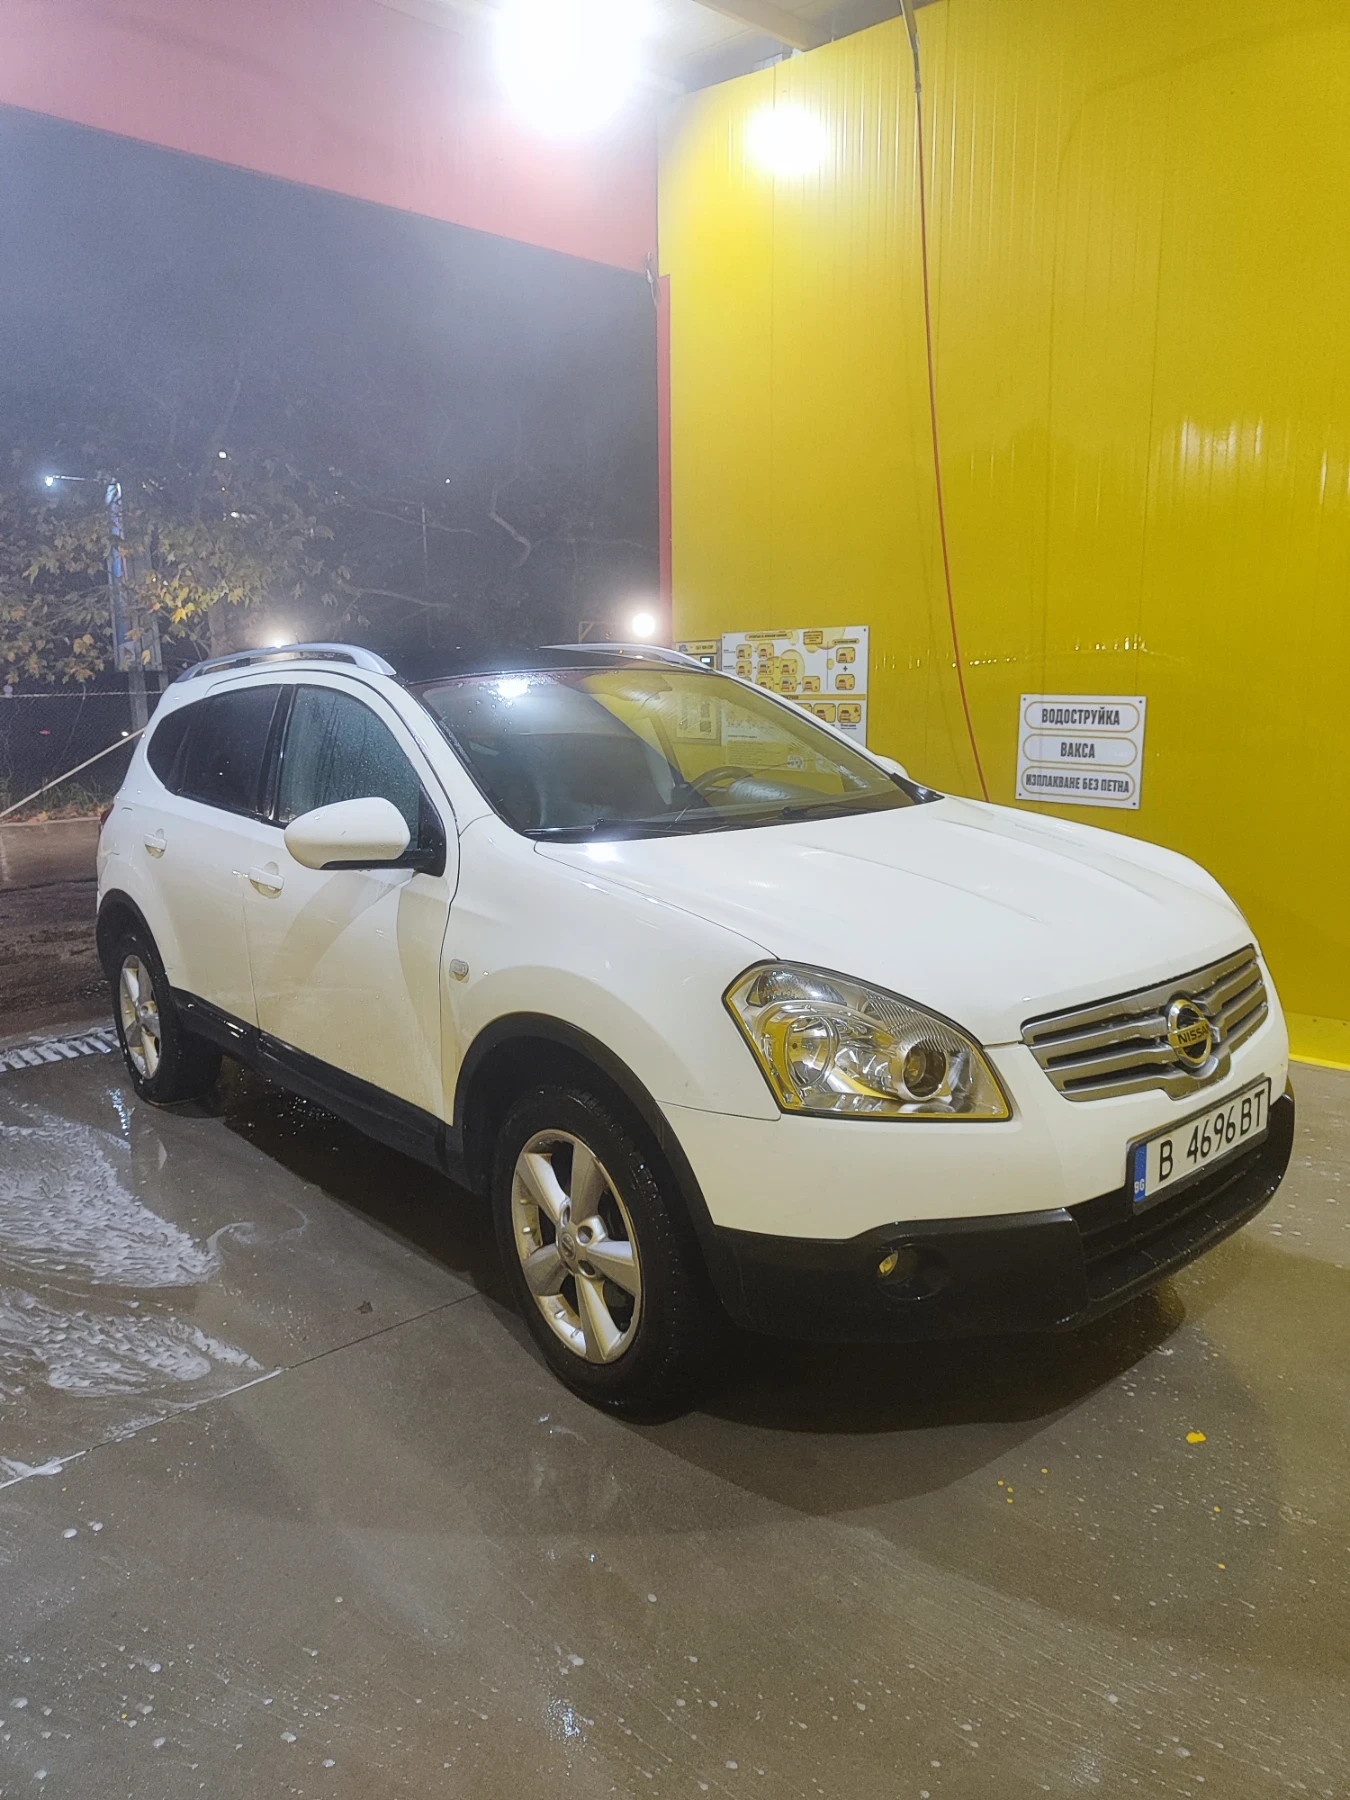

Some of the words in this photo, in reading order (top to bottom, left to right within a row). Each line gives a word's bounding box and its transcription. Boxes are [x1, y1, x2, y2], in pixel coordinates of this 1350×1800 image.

[1041, 706, 1120, 725] ВОДОСТРУЙКА
[1060, 742, 1095, 758] ВАКСА
[1025, 774, 1080, 789] ИЗПЛАКВАНЕ
[1082, 778, 1099, 790] БЕЗ
[1100, 779, 1129, 793] ПЕТНА
[1134, 1178, 1145, 1194] BG
